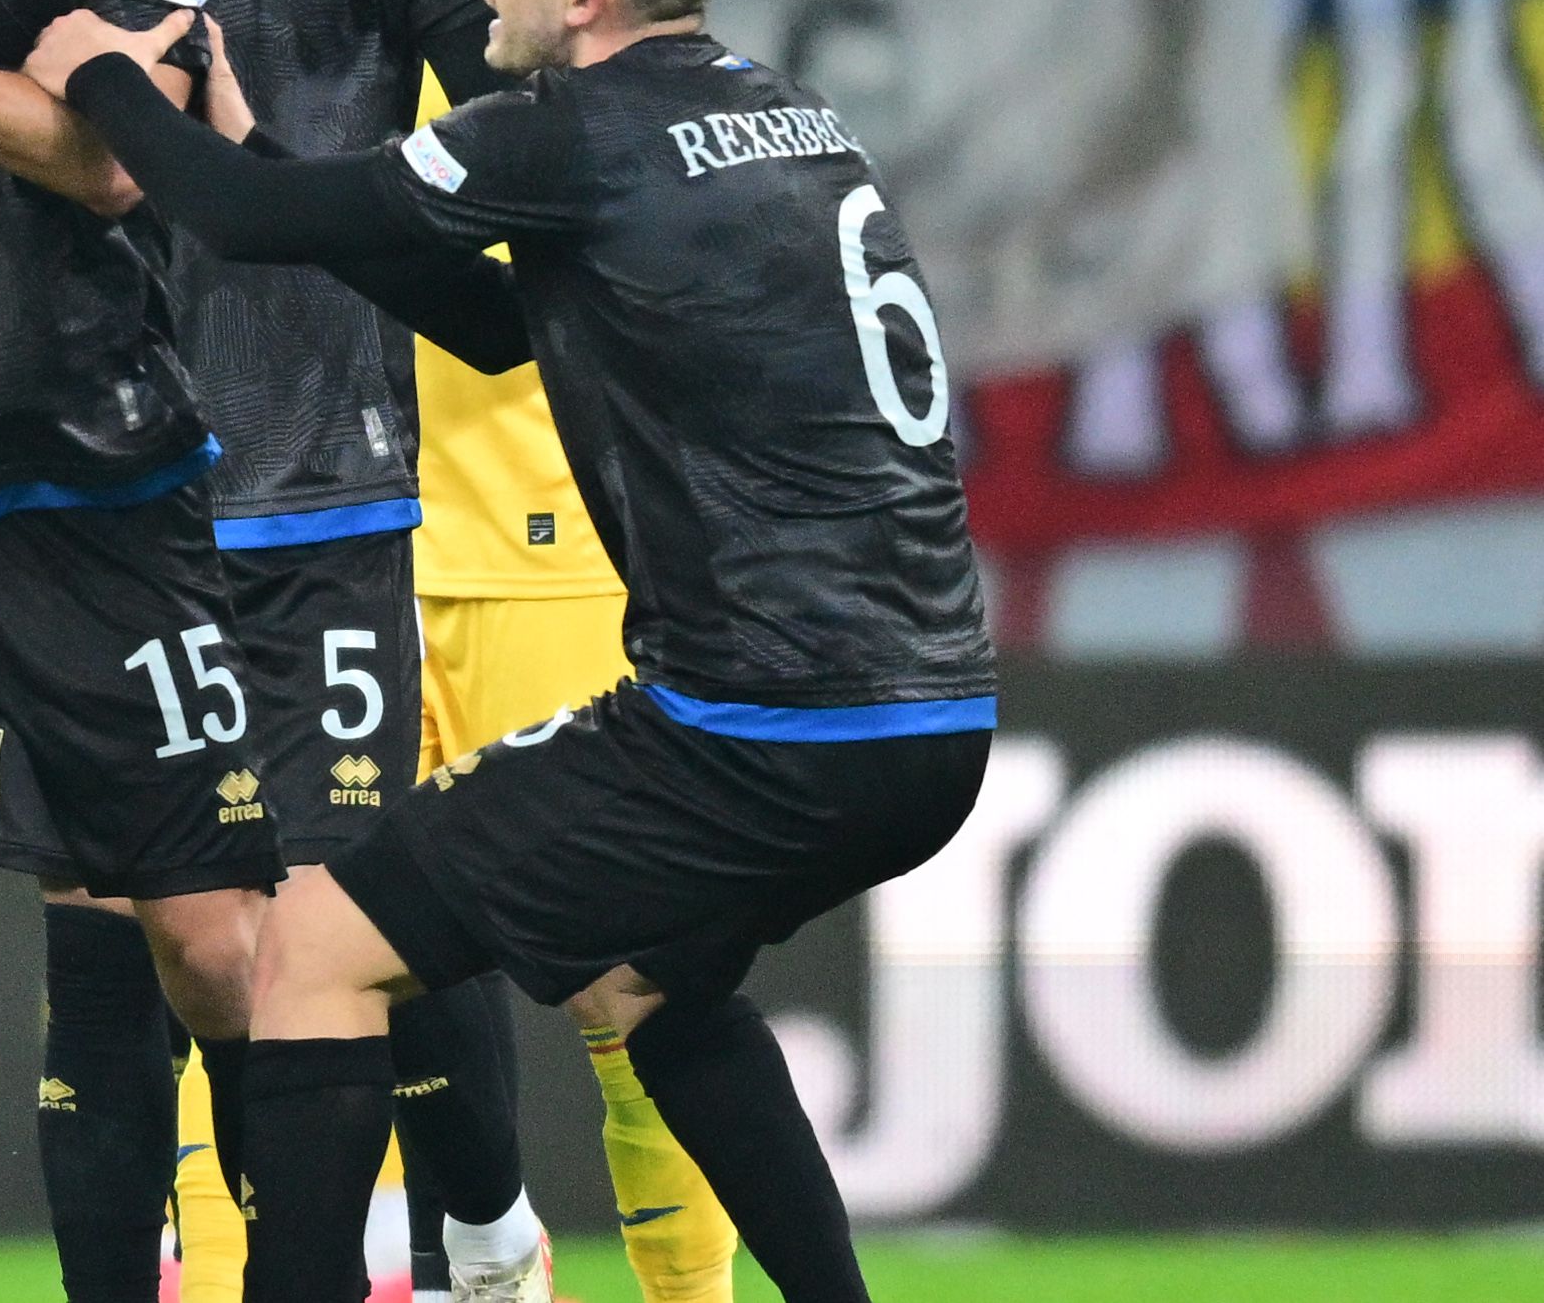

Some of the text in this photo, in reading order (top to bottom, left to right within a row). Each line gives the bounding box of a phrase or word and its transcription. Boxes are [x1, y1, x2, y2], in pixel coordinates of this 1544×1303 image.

[838, 184, 949, 447] 6
[124, 623, 247, 759] 15
[321, 629, 384, 740] 5
[218, 802, 264, 824] errea
[330, 788, 381, 807] errea
